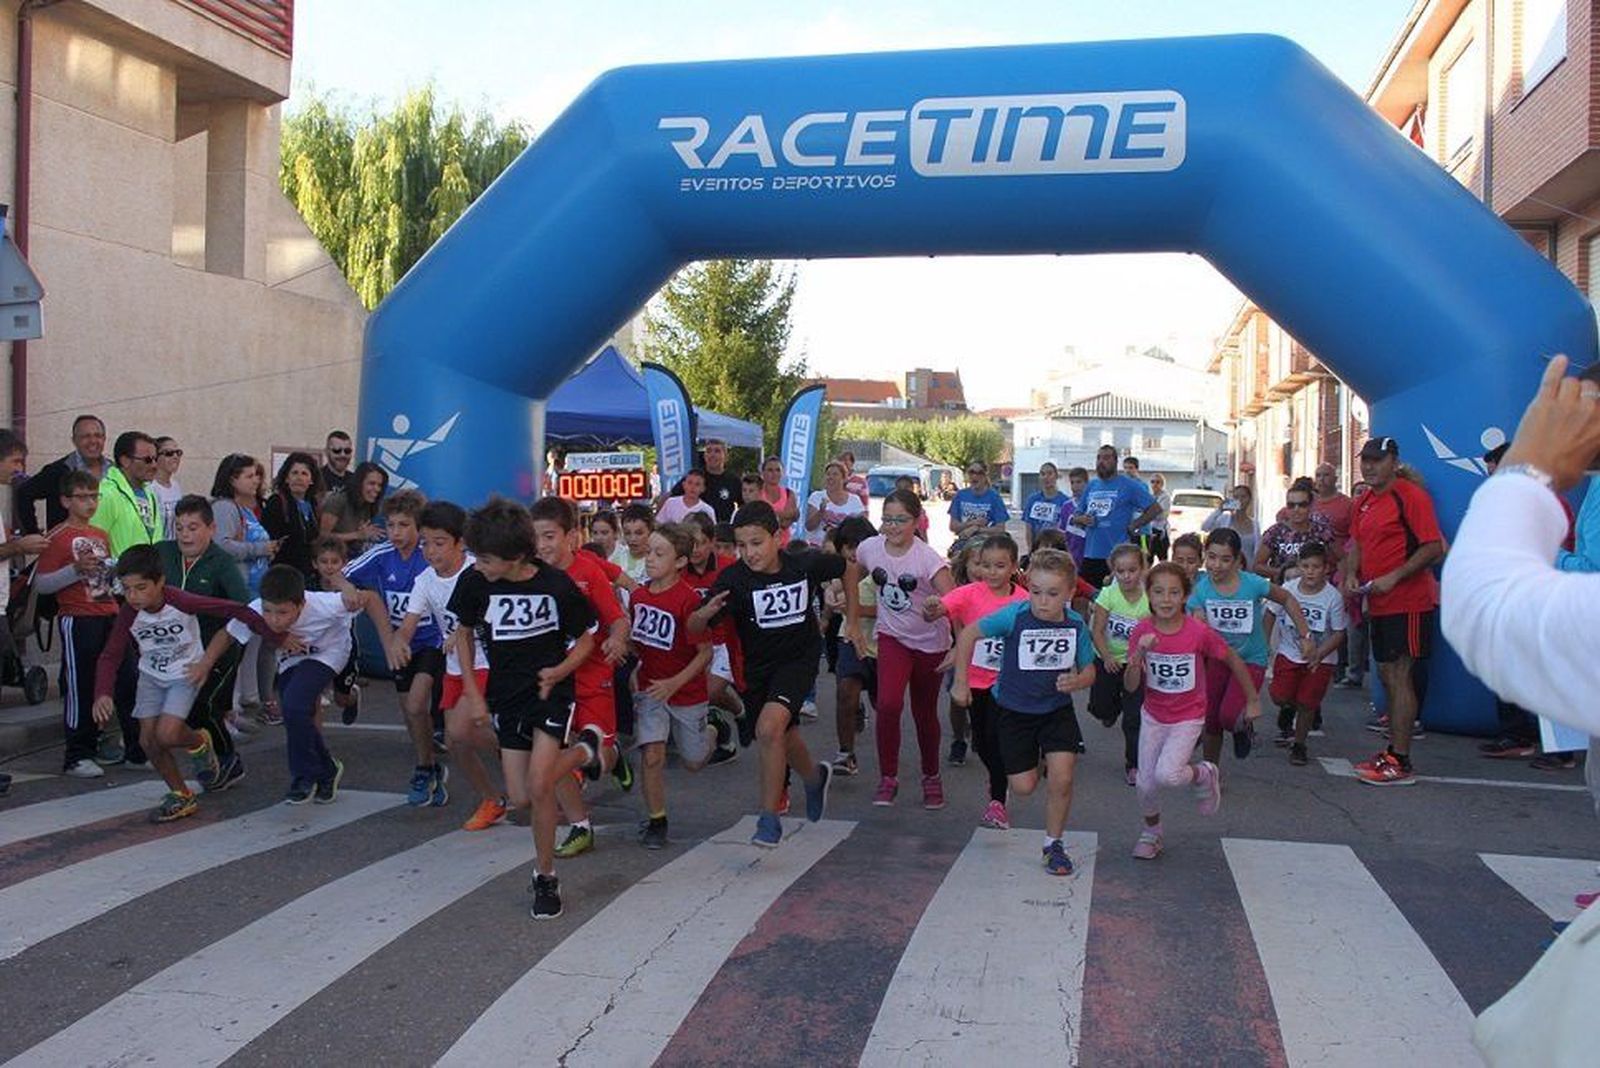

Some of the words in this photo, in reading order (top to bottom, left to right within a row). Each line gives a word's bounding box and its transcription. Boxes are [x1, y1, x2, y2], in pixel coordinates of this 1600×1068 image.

[681, 177, 764, 191] EVENTOS
[772, 174, 896, 190] DEPORTIVOS
[762, 586, 802, 616] 237
[499, 596, 552, 627] 234
[1211, 606, 1248, 620] 188
[637, 606, 671, 639] 230
[138, 623, 184, 641] 200
[1026, 638, 1070, 654] 178
[1150, 662, 1190, 678] 185
